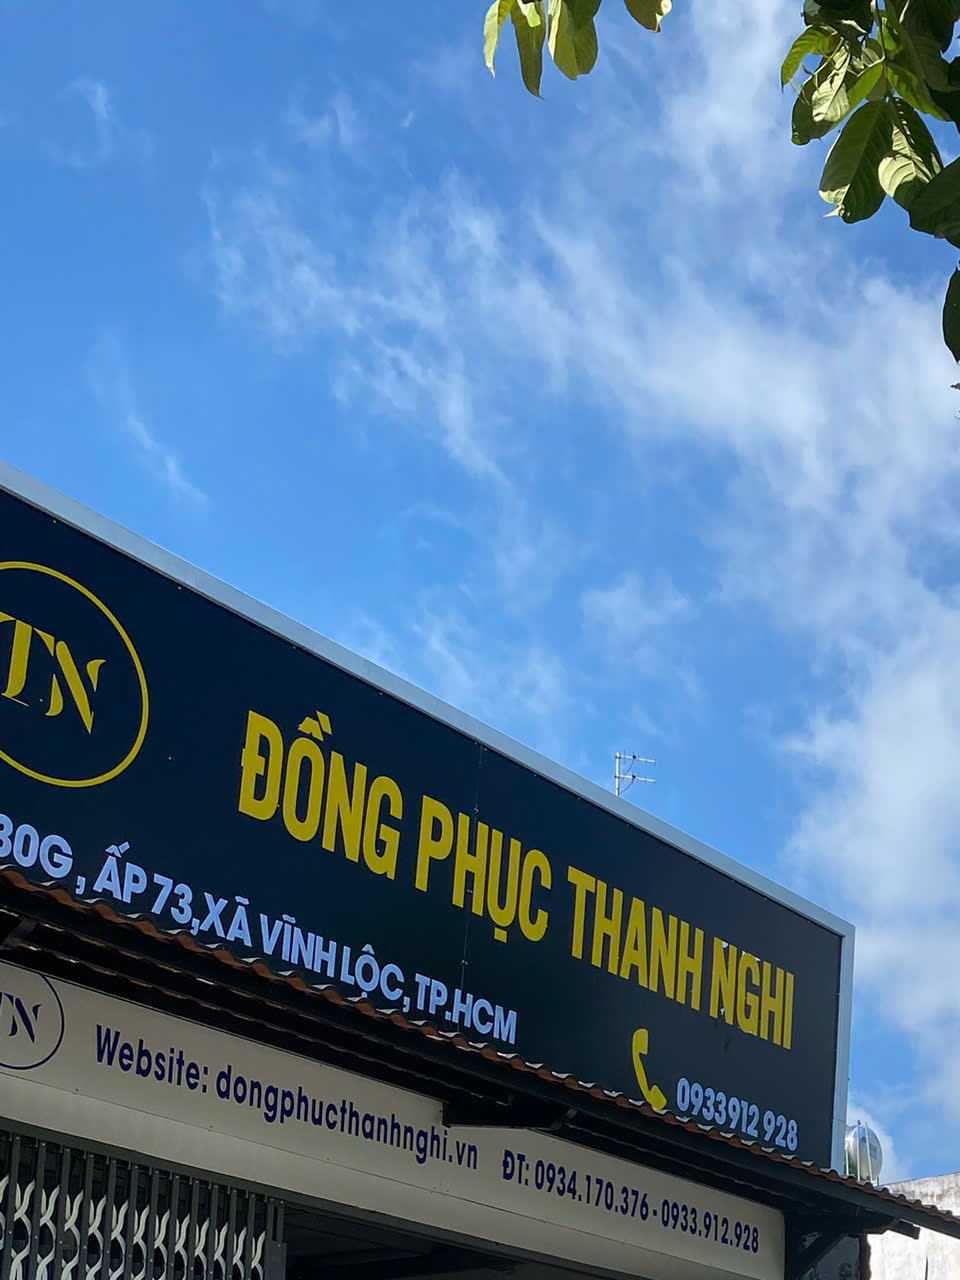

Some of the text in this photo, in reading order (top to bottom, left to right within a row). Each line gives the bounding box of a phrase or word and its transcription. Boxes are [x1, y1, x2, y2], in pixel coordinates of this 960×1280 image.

[238, 709, 795, 1050] ĐỒNG PHỤC THANH NGHI
[259, 913, 337, 978] VĨNH
[96, 1024, 208, 1093] Website:
[216, 1064, 478, 1170] dongphucthanhnghi.vn
[502, 1149, 529, 1186] ĐT:
